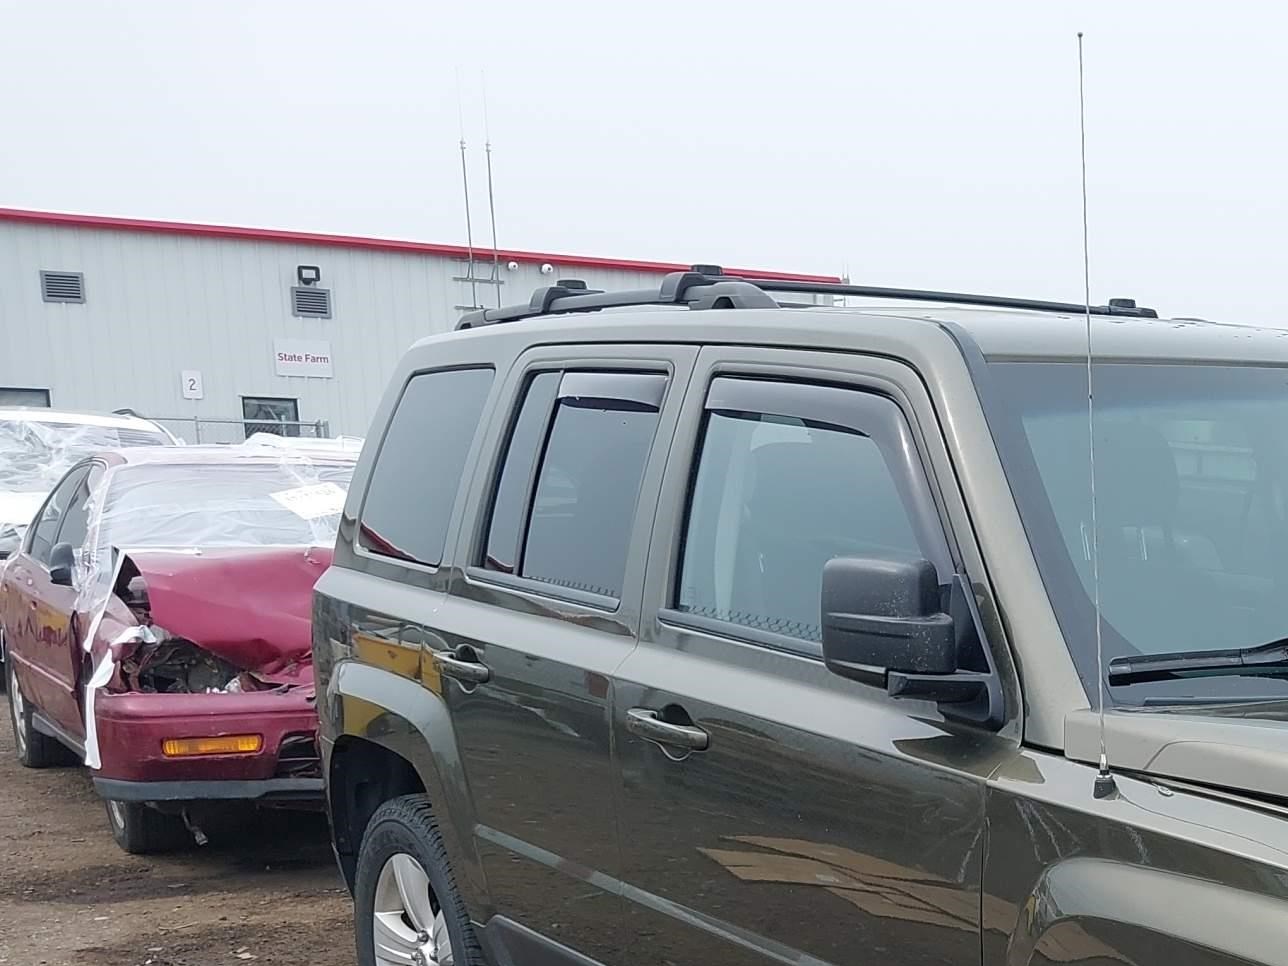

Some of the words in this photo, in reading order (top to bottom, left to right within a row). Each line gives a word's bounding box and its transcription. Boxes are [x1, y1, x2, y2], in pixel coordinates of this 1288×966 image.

[277, 352, 303, 362] State
[304, 353, 329, 363] Farm
[188, 378, 198, 391] 2
